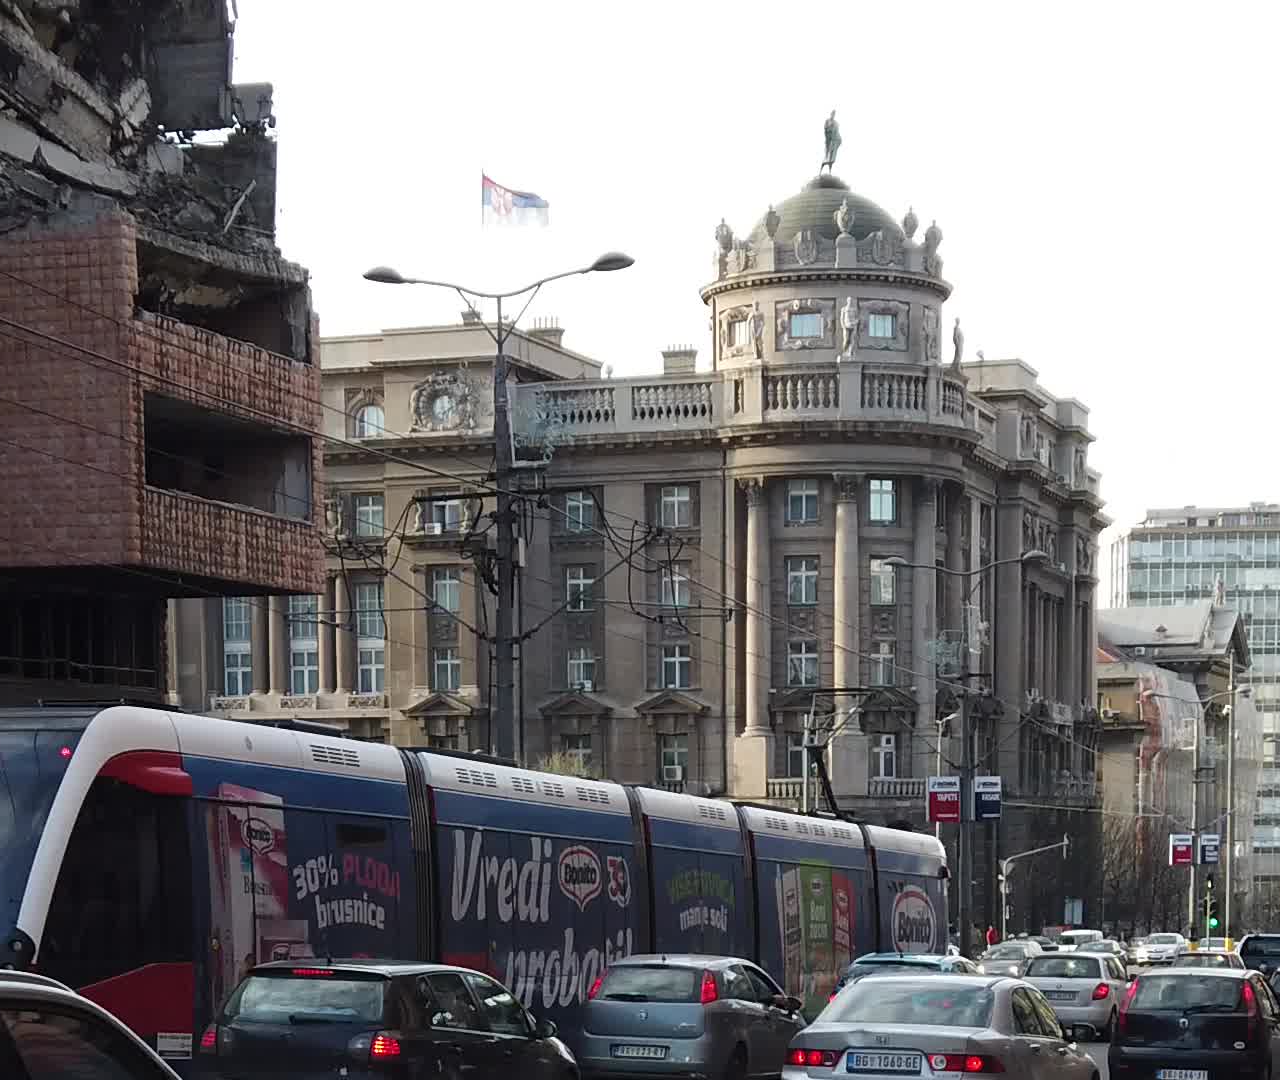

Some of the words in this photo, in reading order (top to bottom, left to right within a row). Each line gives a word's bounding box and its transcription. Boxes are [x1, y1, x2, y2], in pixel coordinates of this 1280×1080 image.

[293, 854, 339, 900] 30%
[451, 830, 552, 923] Vredi
[315, 891, 385, 930] brusnice
